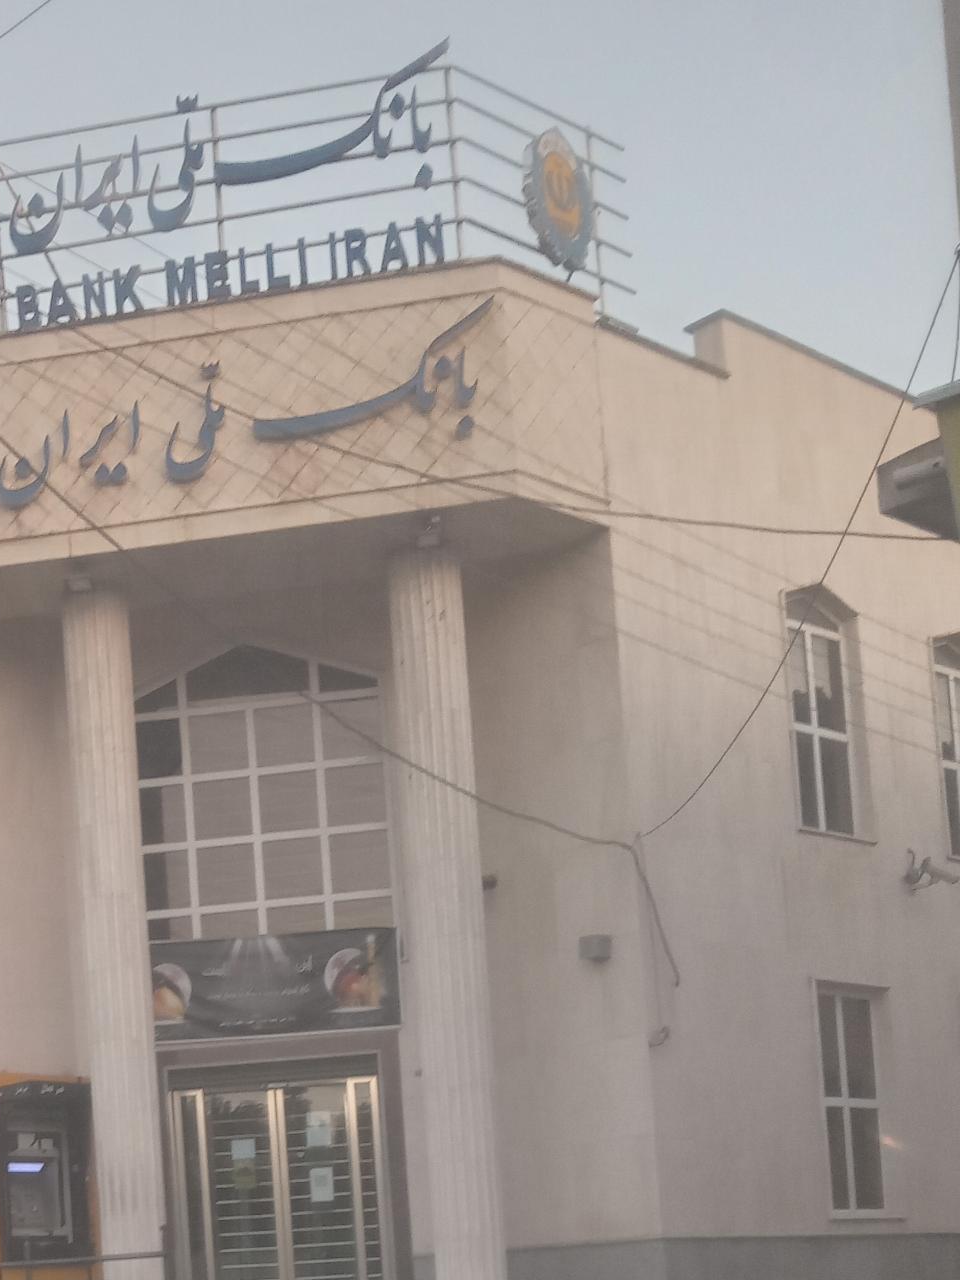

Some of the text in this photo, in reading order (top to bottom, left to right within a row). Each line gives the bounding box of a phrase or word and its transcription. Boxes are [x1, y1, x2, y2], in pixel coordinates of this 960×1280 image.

[216, 37, 449, 190] بانک
[10, 134, 140, 256] ایران
[15, 213, 445, 332] BANK MELLI IRAN
[253, 296, 494, 442] بانک
